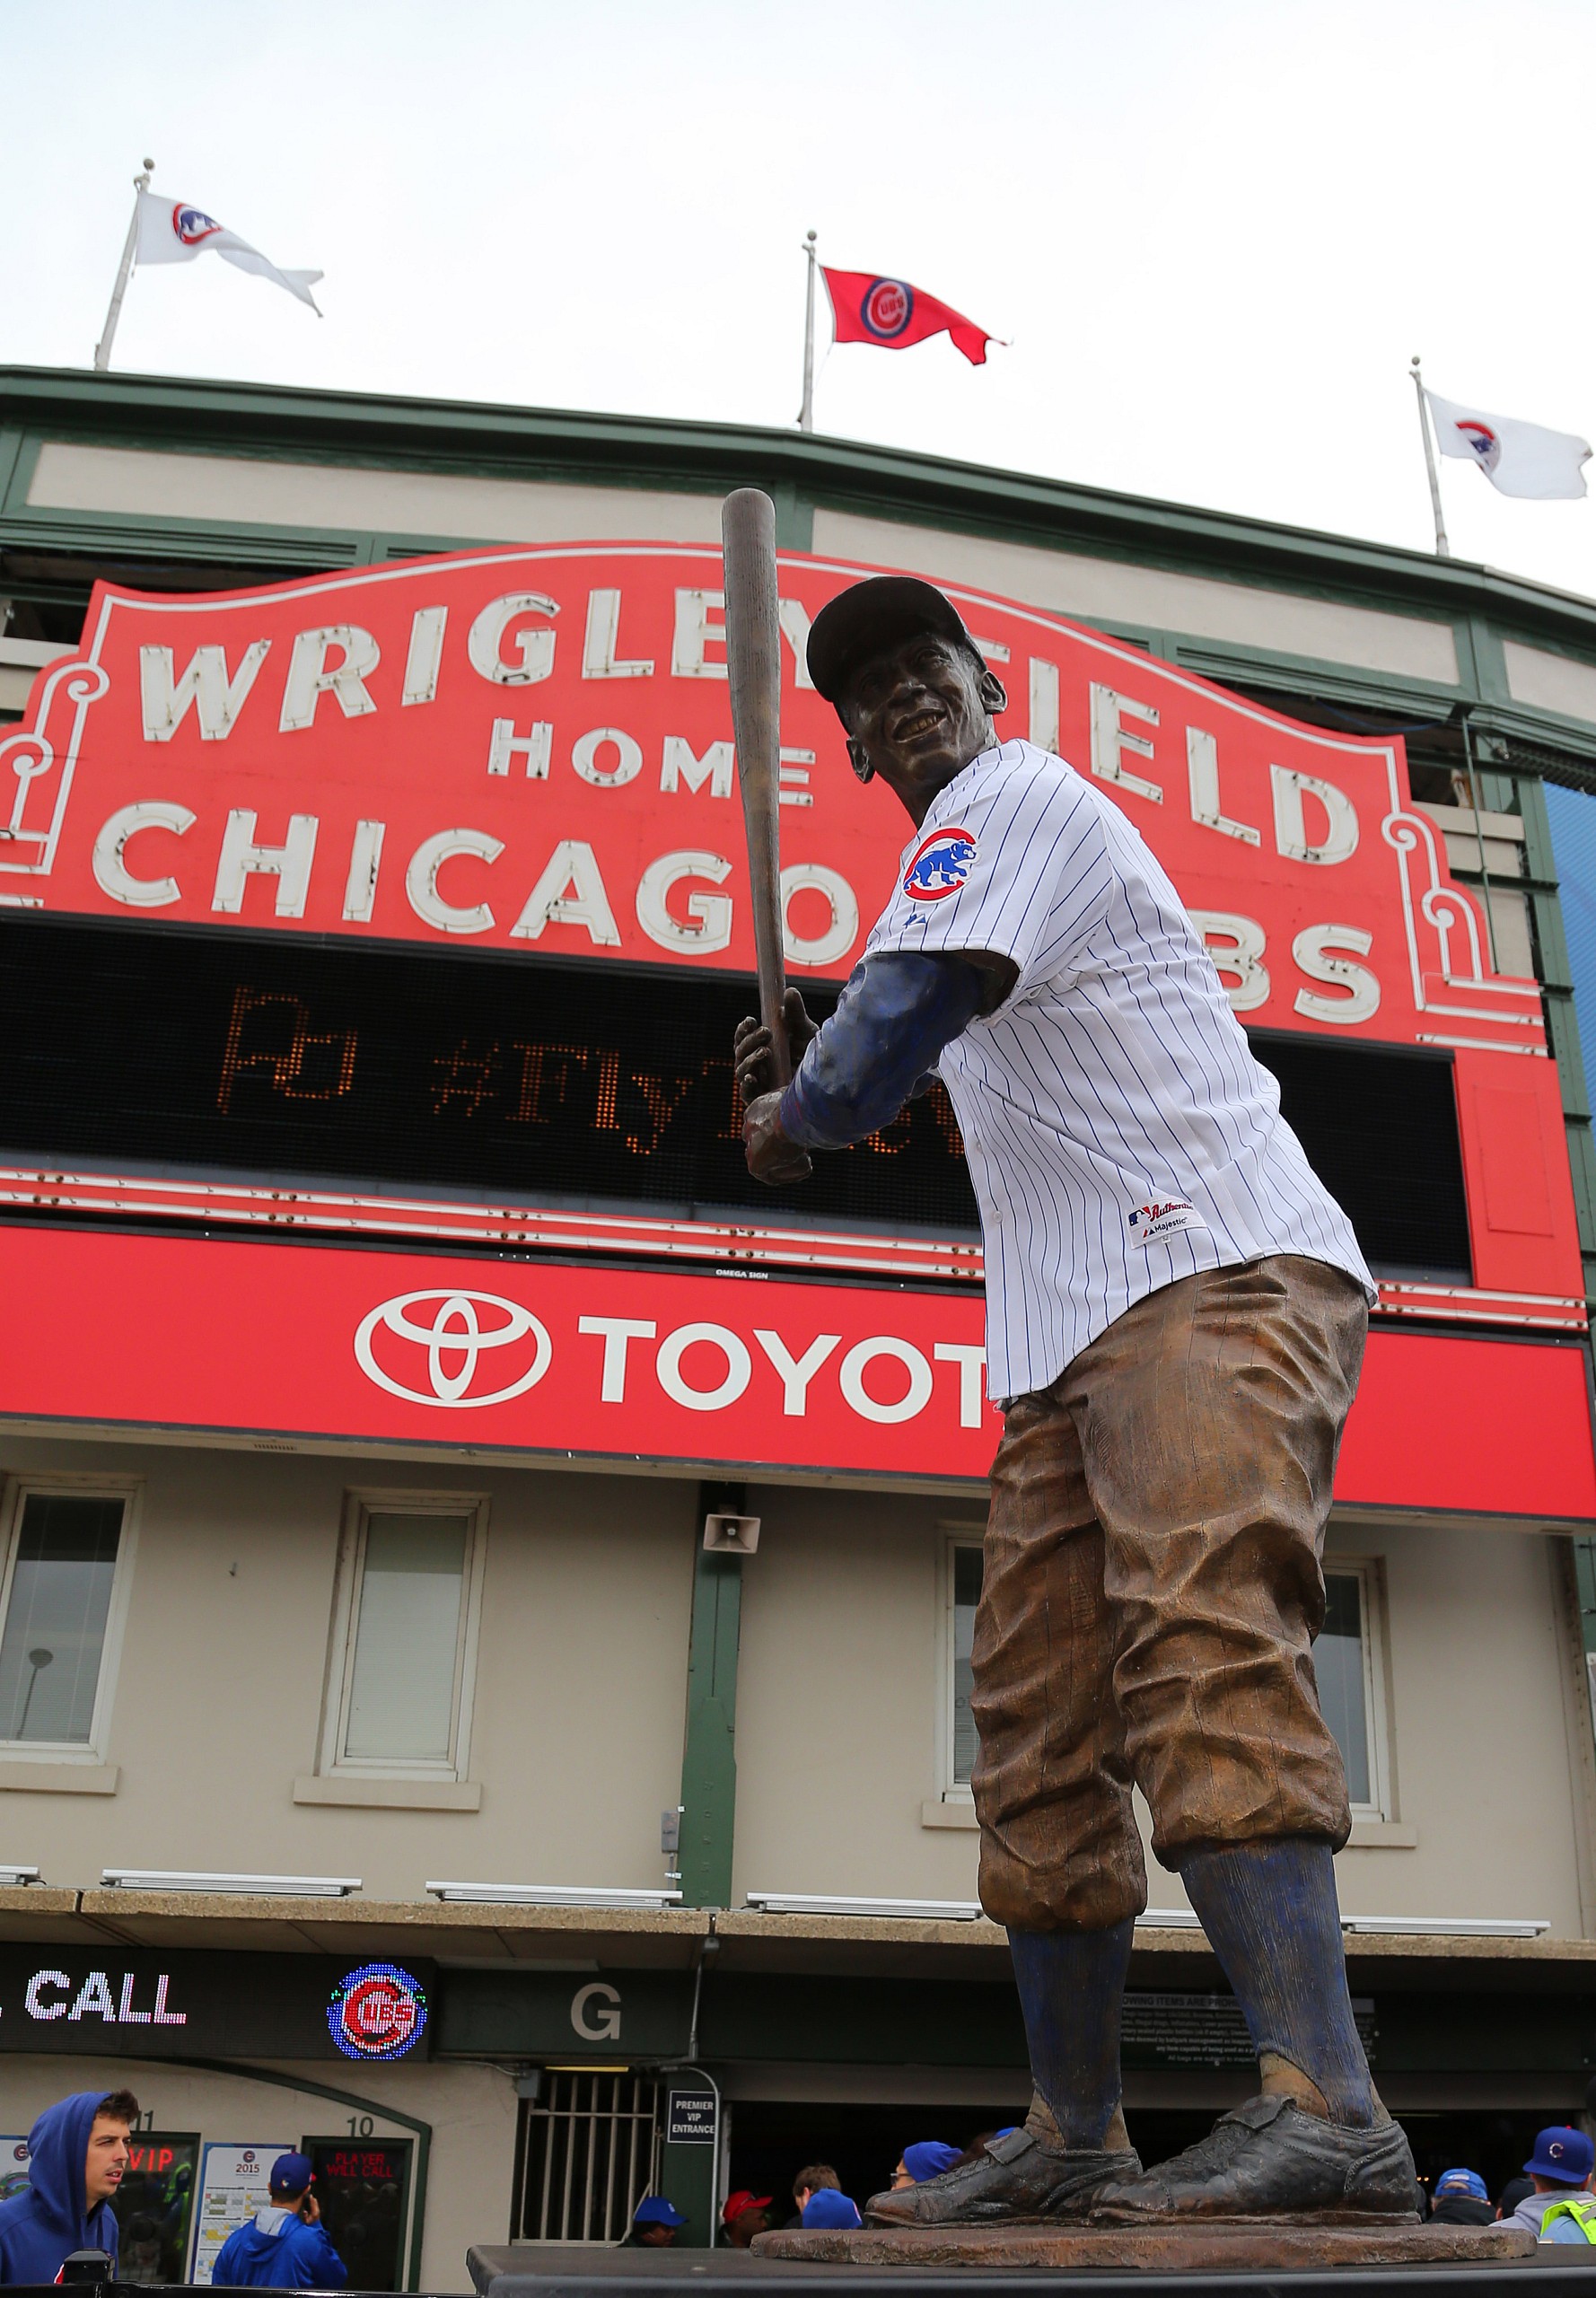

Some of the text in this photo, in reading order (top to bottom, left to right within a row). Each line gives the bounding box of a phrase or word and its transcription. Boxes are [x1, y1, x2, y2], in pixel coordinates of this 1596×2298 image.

[972, 636, 1361, 866] IELD
[487, 718, 816, 807] HOME
[92, 800, 1381, 1025] CHICAGO BS
[1153, 1217, 1187, 1232] Majestic
[715, 1268, 769, 1280] OMEGA SIGN
[578, 1315, 987, 1429] TOYOT
[25, 1969, 187, 2024] CALL
[1122, 1996, 1154, 2005] OWING
[1156, 1996, 1185, 2006] ITEMS
[1187, 1997, 1206, 2007] ARE
[571, 1982, 621, 2041] G
[676, 2101, 714, 2110] PREMIER
[687, 2112, 702, 2122] VIP
[347, 2117, 373, 2137] 10
[671, 2124, 715, 2134] ENTRANCE
[1548, 2143, 1564, 2158] C
[128, 2146, 173, 2171] VIP
[335, 2153, 384, 2165] PLAYER
[235, 2163, 260, 2173] 2015
[327, 2163, 392, 2179] WILL CALL
